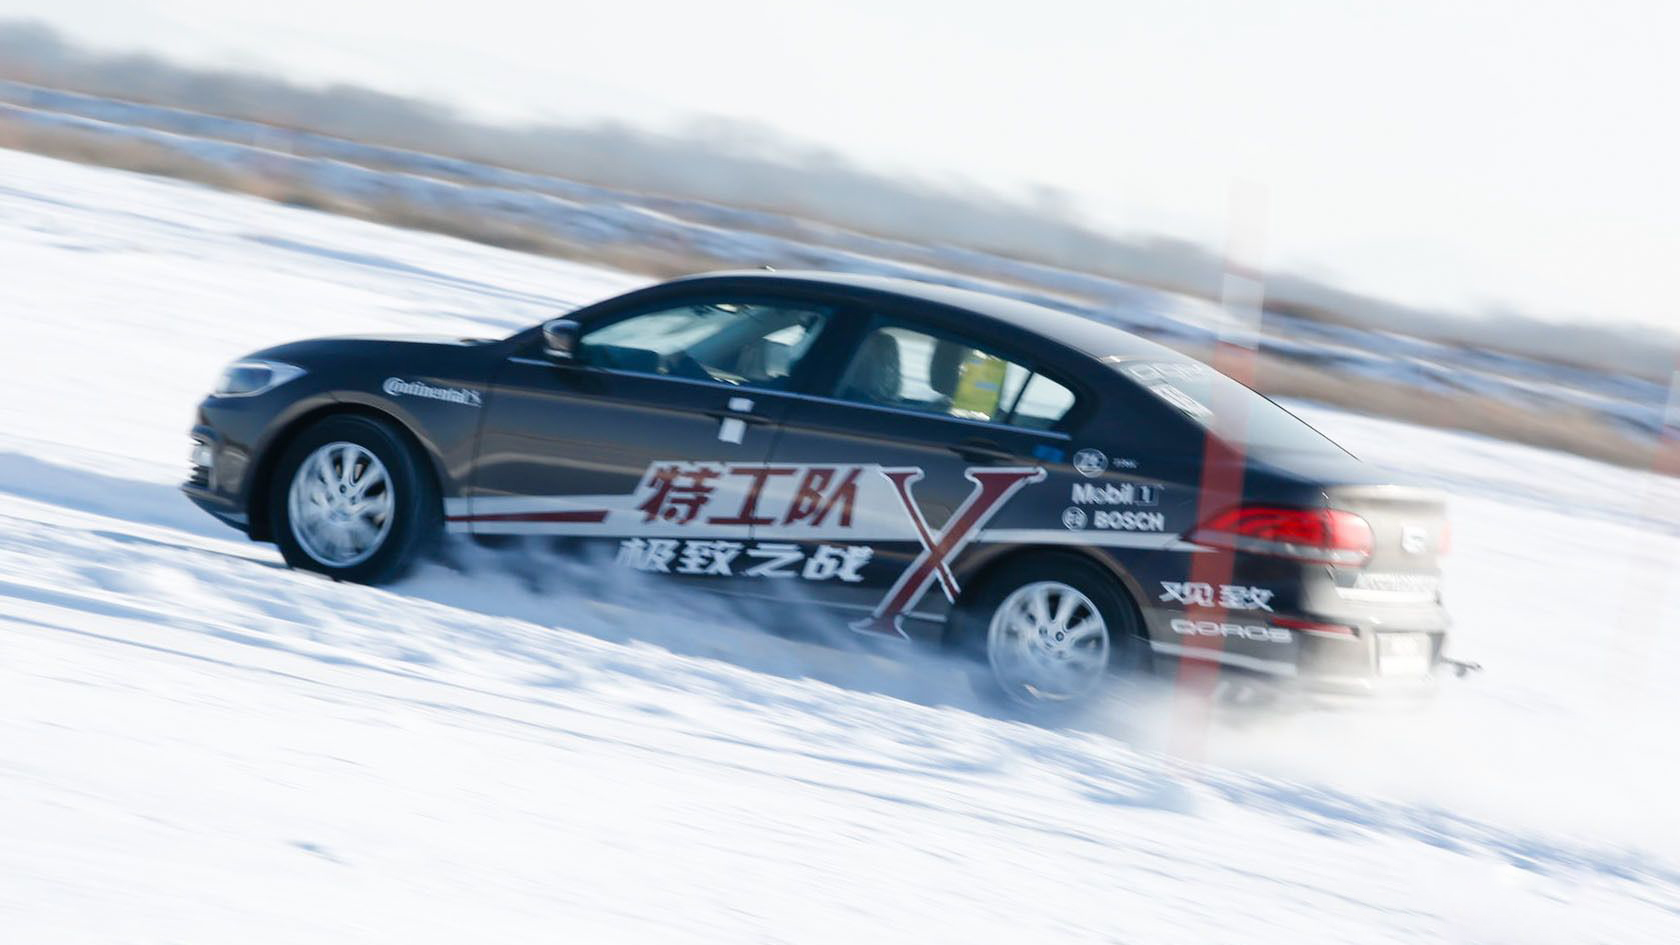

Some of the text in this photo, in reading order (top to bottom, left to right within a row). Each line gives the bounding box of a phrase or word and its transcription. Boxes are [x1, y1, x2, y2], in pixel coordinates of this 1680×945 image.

[639, 465, 861, 527] 特工队
[1072, 483, 1134, 505] Mobil
[1094, 510, 1165, 531] BOSCH
[615, 538, 874, 582] 极致之战
[1159, 581, 1274, 612] 观致
